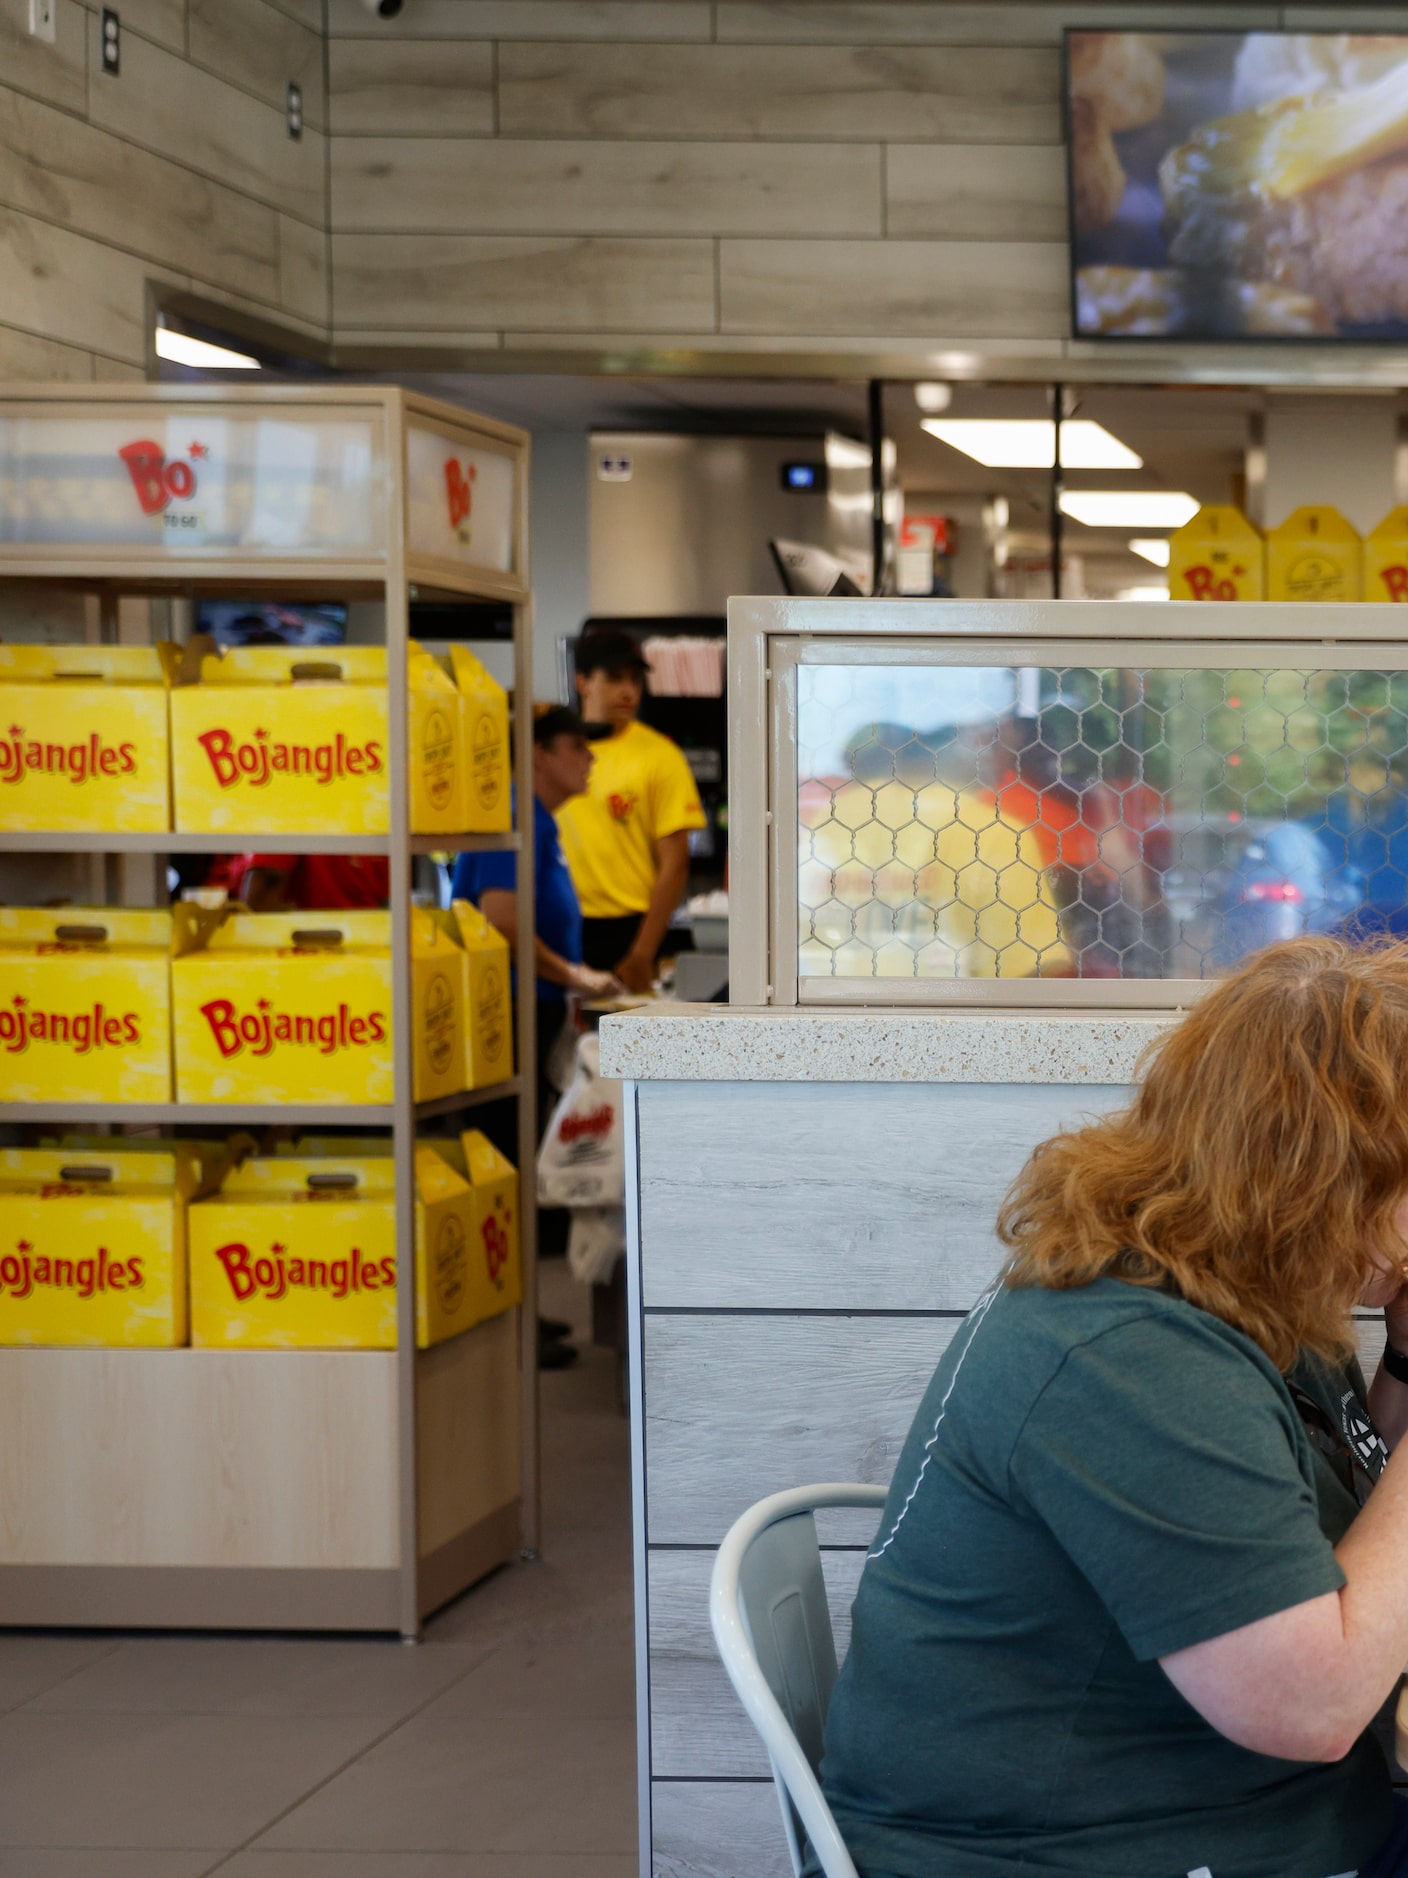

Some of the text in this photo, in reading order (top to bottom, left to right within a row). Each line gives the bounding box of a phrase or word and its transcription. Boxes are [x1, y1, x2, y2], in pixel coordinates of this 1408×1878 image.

[0, 724, 137, 784] ojangles
[198, 727, 383, 788] Bojangles
[0, 994, 139, 1054] ojangles
[201, 999, 386, 1058] Bojangles
[0, 1241, 144, 1297] ojangles
[216, 1242, 397, 1301] Bojangles
